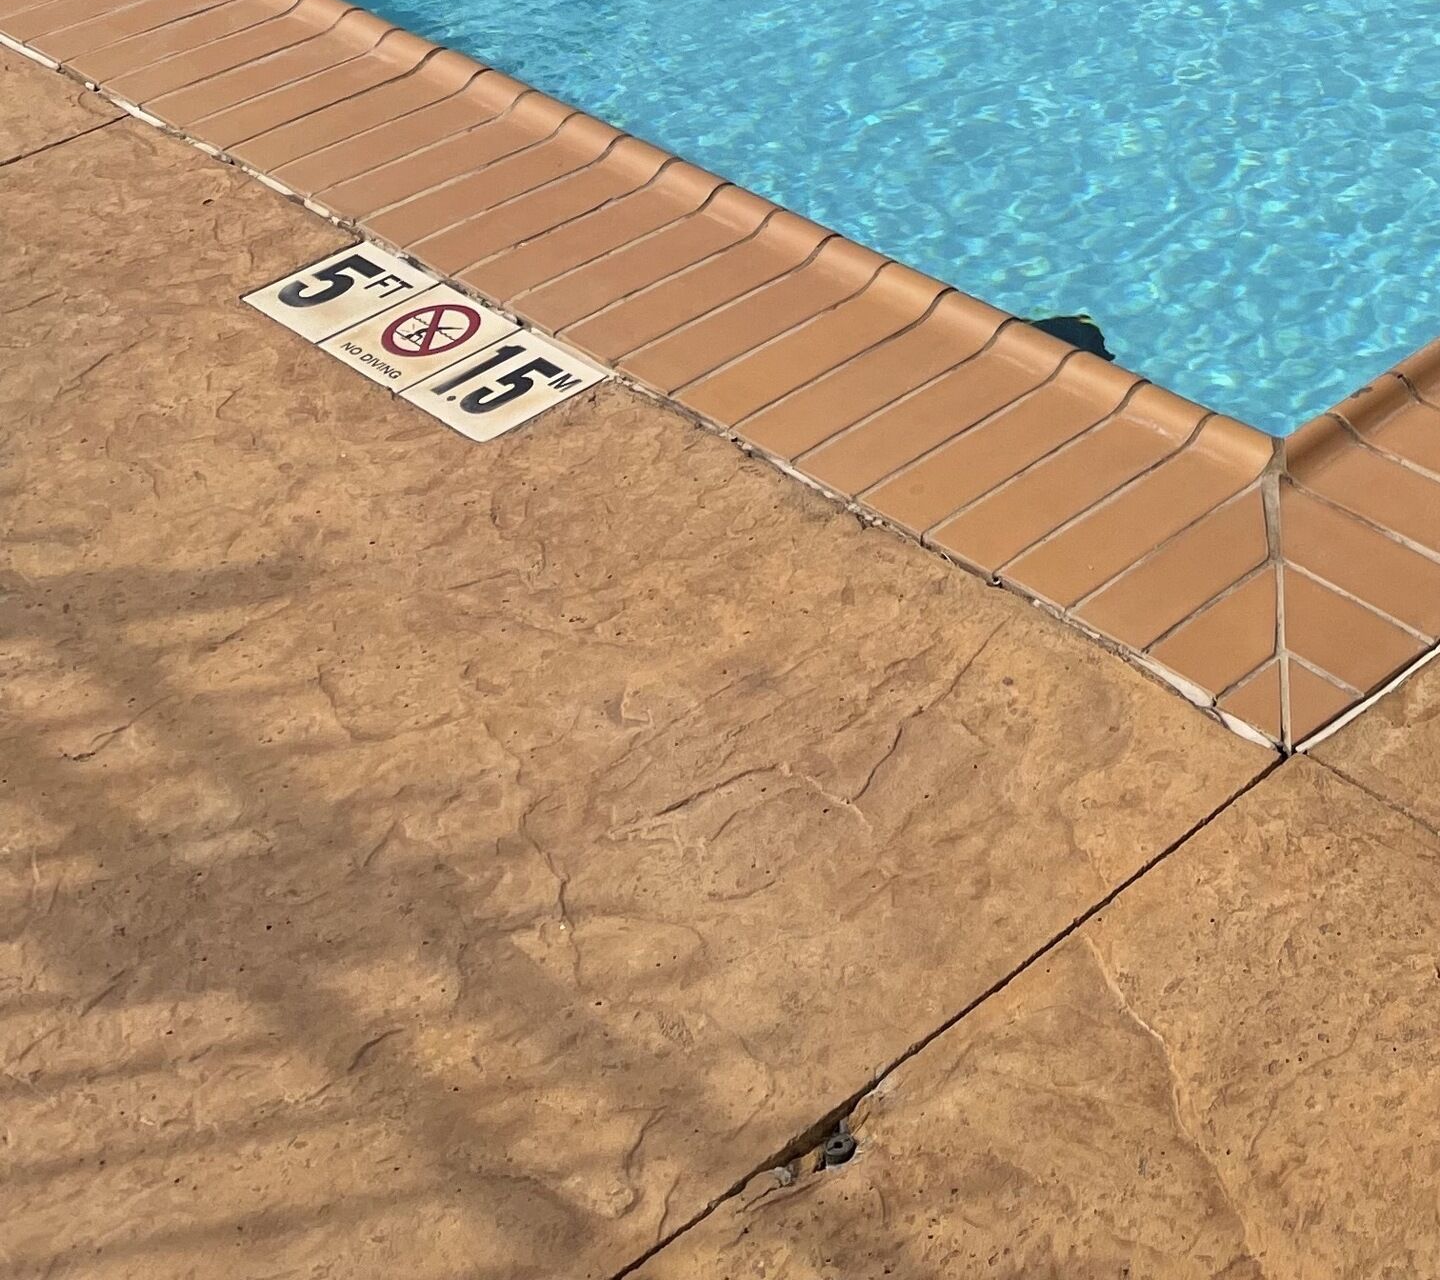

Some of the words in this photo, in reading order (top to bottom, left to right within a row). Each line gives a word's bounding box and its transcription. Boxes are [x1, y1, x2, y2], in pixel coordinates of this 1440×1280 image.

[277, 254, 386, 308] 5
[363, 273, 415, 299] FT
[340, 341, 363, 356] NO
[360, 352, 403, 380] DIVING
